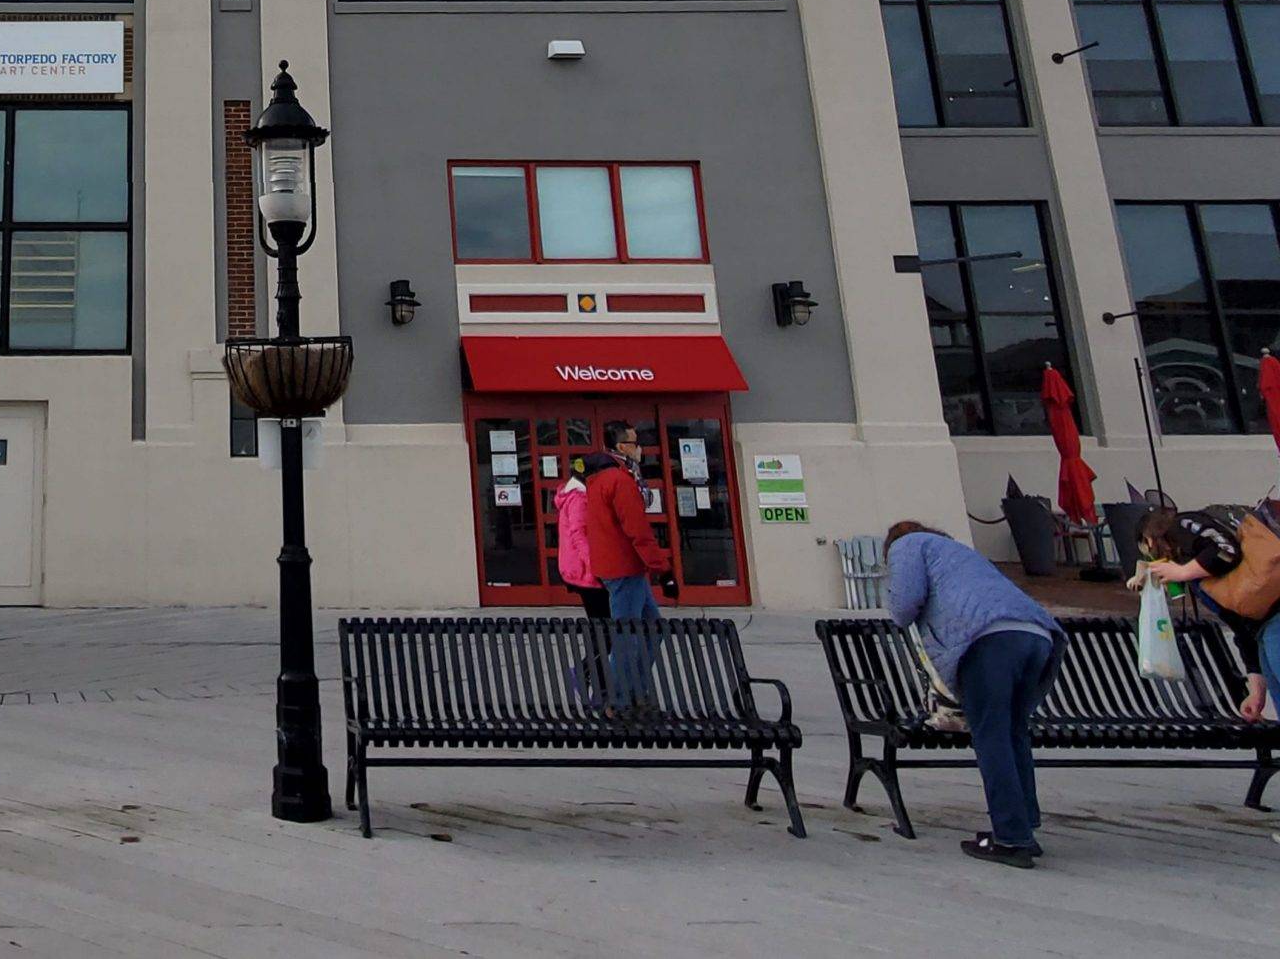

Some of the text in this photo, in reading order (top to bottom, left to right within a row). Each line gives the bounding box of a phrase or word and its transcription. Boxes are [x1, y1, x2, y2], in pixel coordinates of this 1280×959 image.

[0, 54, 117, 64] TORPEDO FACTORY
[0, 66, 86, 75] ART CENTER
[556, 365, 655, 382] Welcome
[764, 507, 806, 521] OPEN
